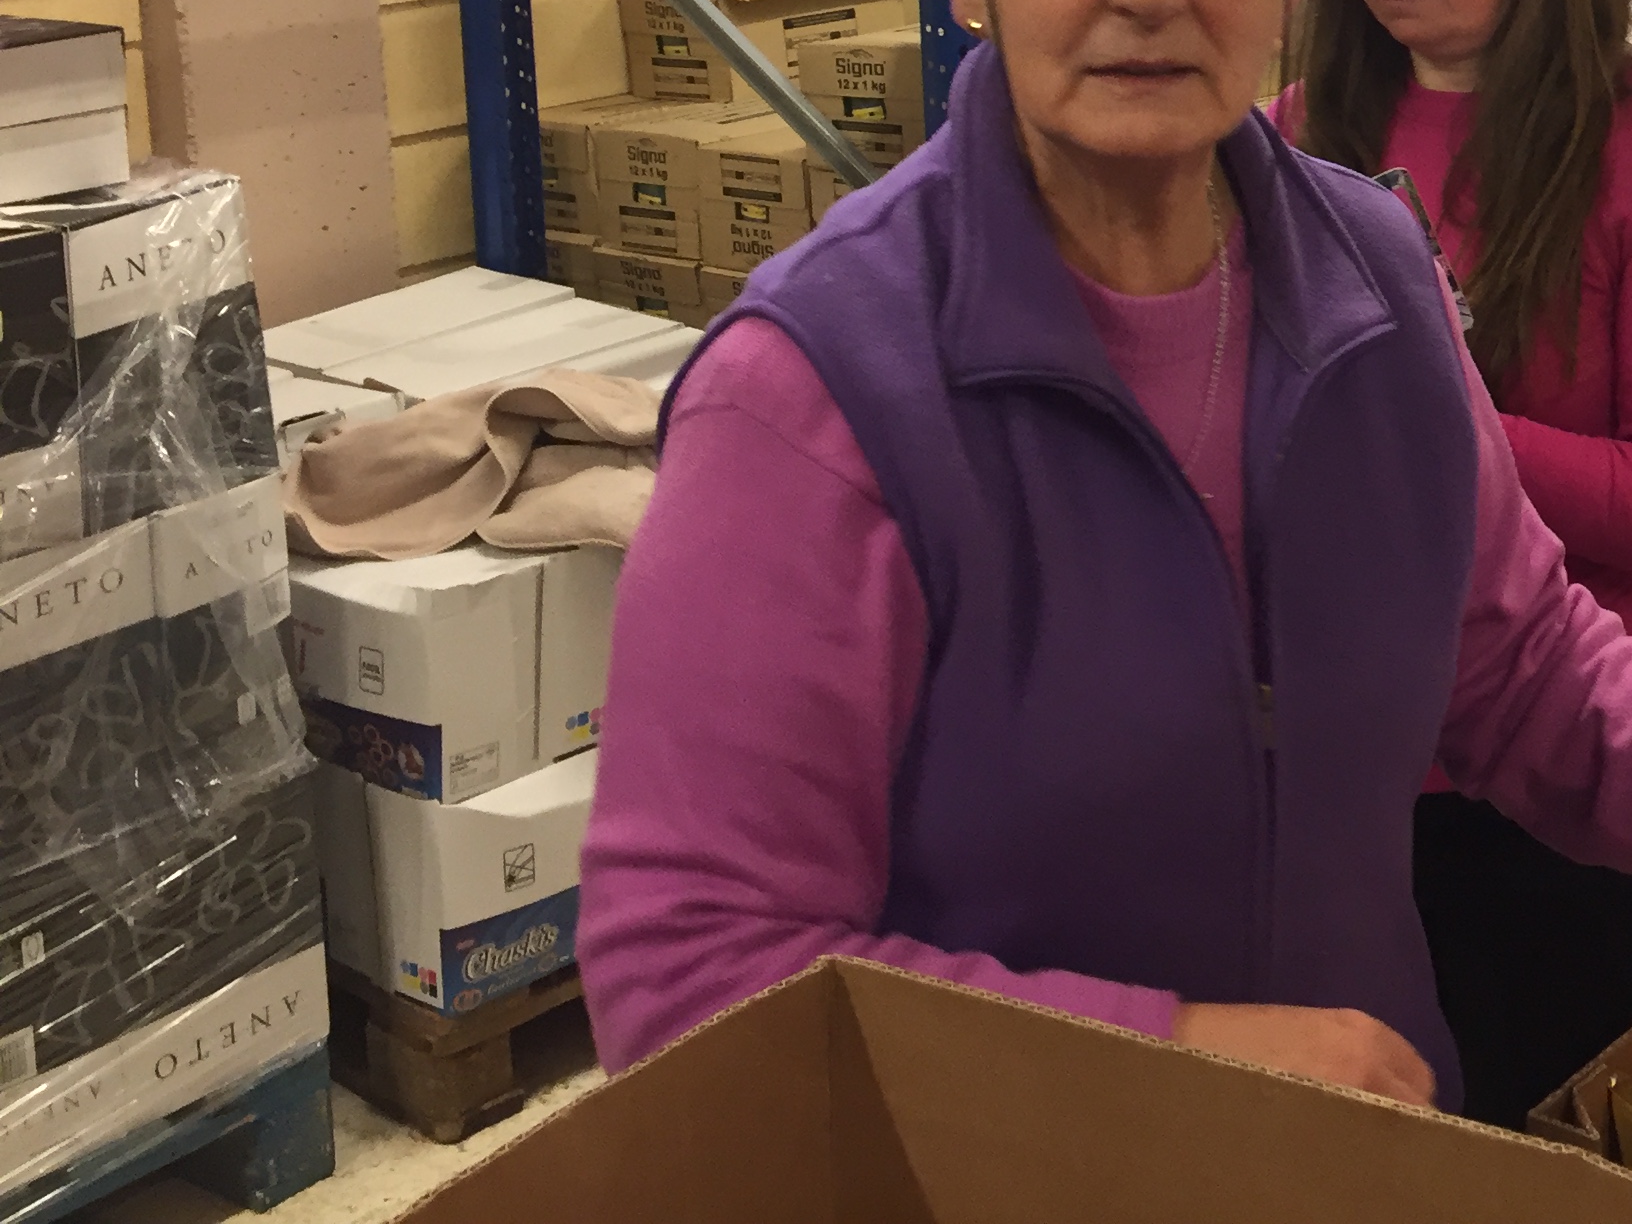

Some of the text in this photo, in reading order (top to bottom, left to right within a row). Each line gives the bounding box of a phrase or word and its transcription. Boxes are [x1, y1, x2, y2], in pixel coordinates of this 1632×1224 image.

[837, 78, 886, 94] 12 x 1 kg
[464, 926, 558, 982] Chaskis
[154, 989, 303, 1080] ANETO
